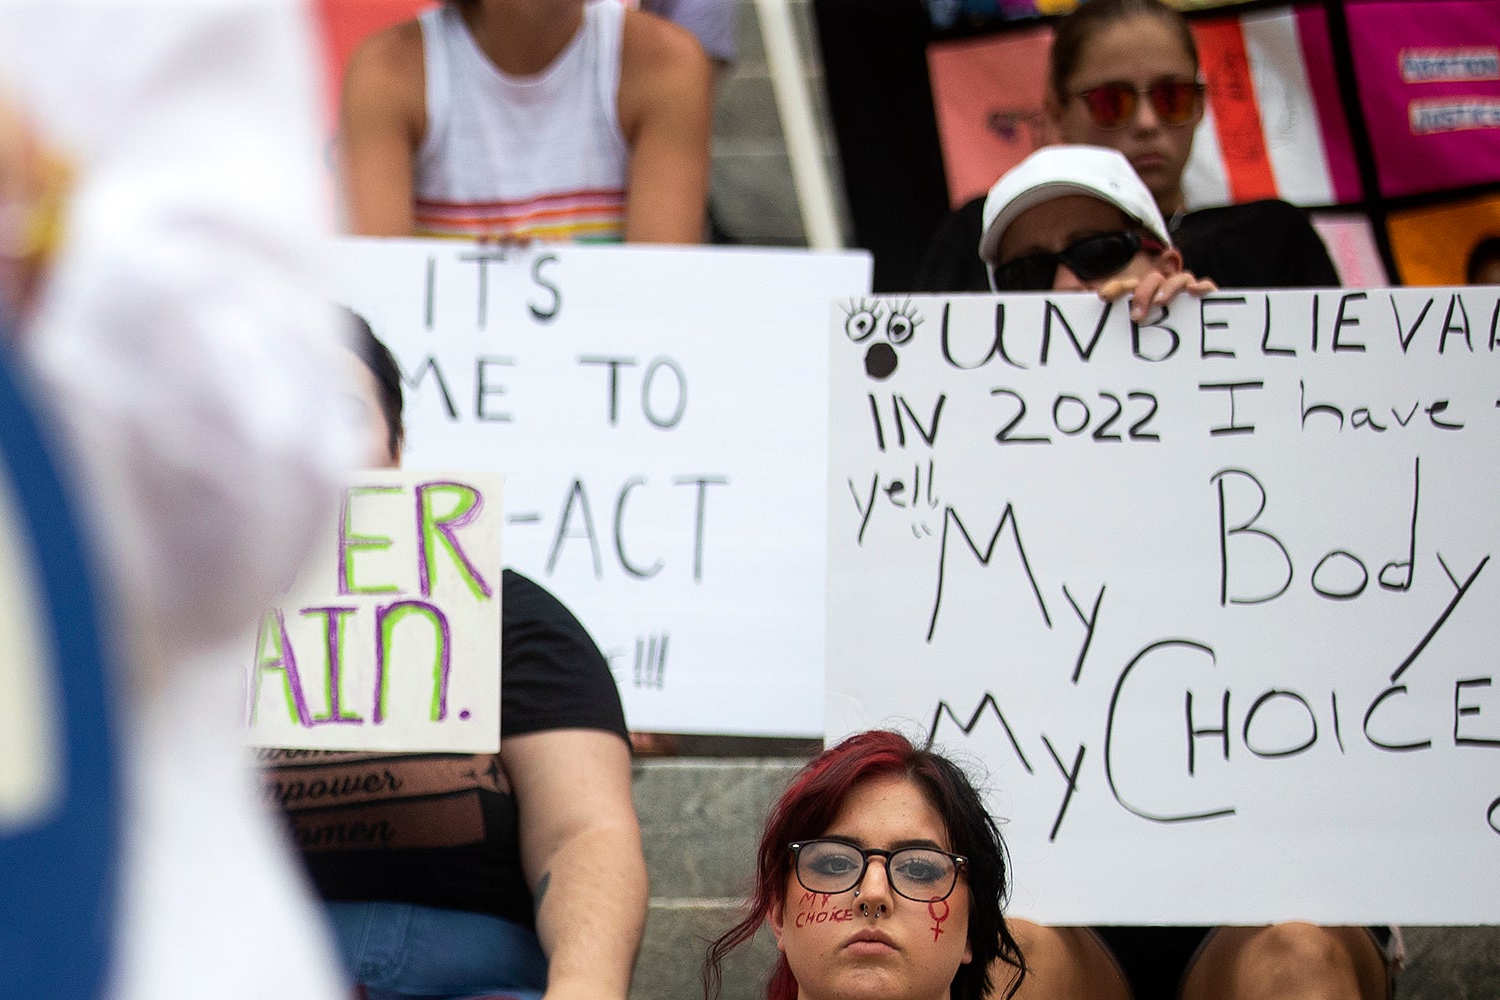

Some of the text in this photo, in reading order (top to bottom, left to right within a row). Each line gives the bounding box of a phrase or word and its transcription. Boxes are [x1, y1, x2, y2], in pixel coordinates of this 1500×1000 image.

[940, 292, 1500, 370] UNBELIEVA
[577, 353, 687, 427] TO
[867, 377, 1466, 451] IN 2022 I have
[1209, 456, 1492, 683] Body
[246, 600, 470, 728] AIN.
[925, 638, 1500, 842] My CHOICE
